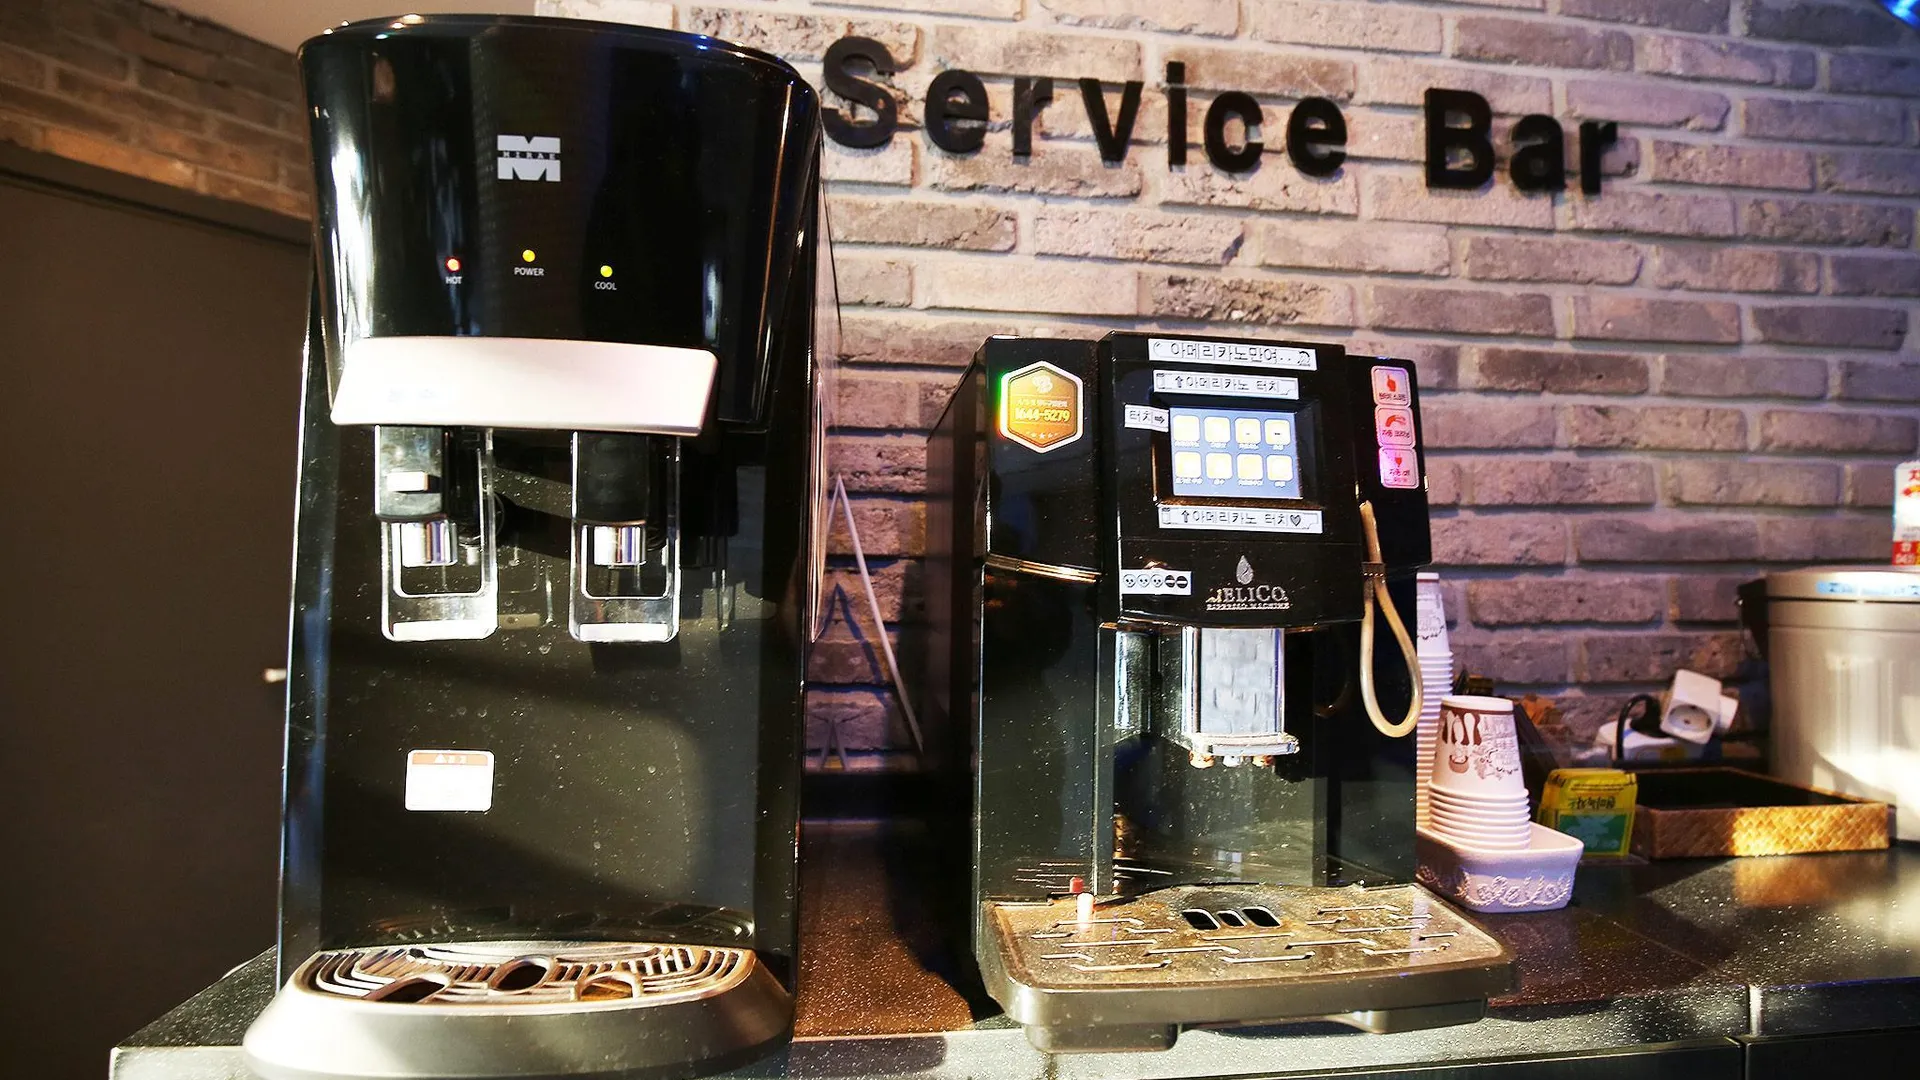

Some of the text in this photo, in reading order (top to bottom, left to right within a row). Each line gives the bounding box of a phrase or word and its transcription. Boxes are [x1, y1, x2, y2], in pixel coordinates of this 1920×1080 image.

[823, 35, 1618, 194] Service Bar
[514, 267, 545, 276] POWER
[445, 276, 463, 285] HOT
[594, 281, 617, 291] COOL
[1256, 379, 1280, 393] 터치
[1129, 409, 1154, 423] 터치
[1264, 513, 1289, 525] 터치
